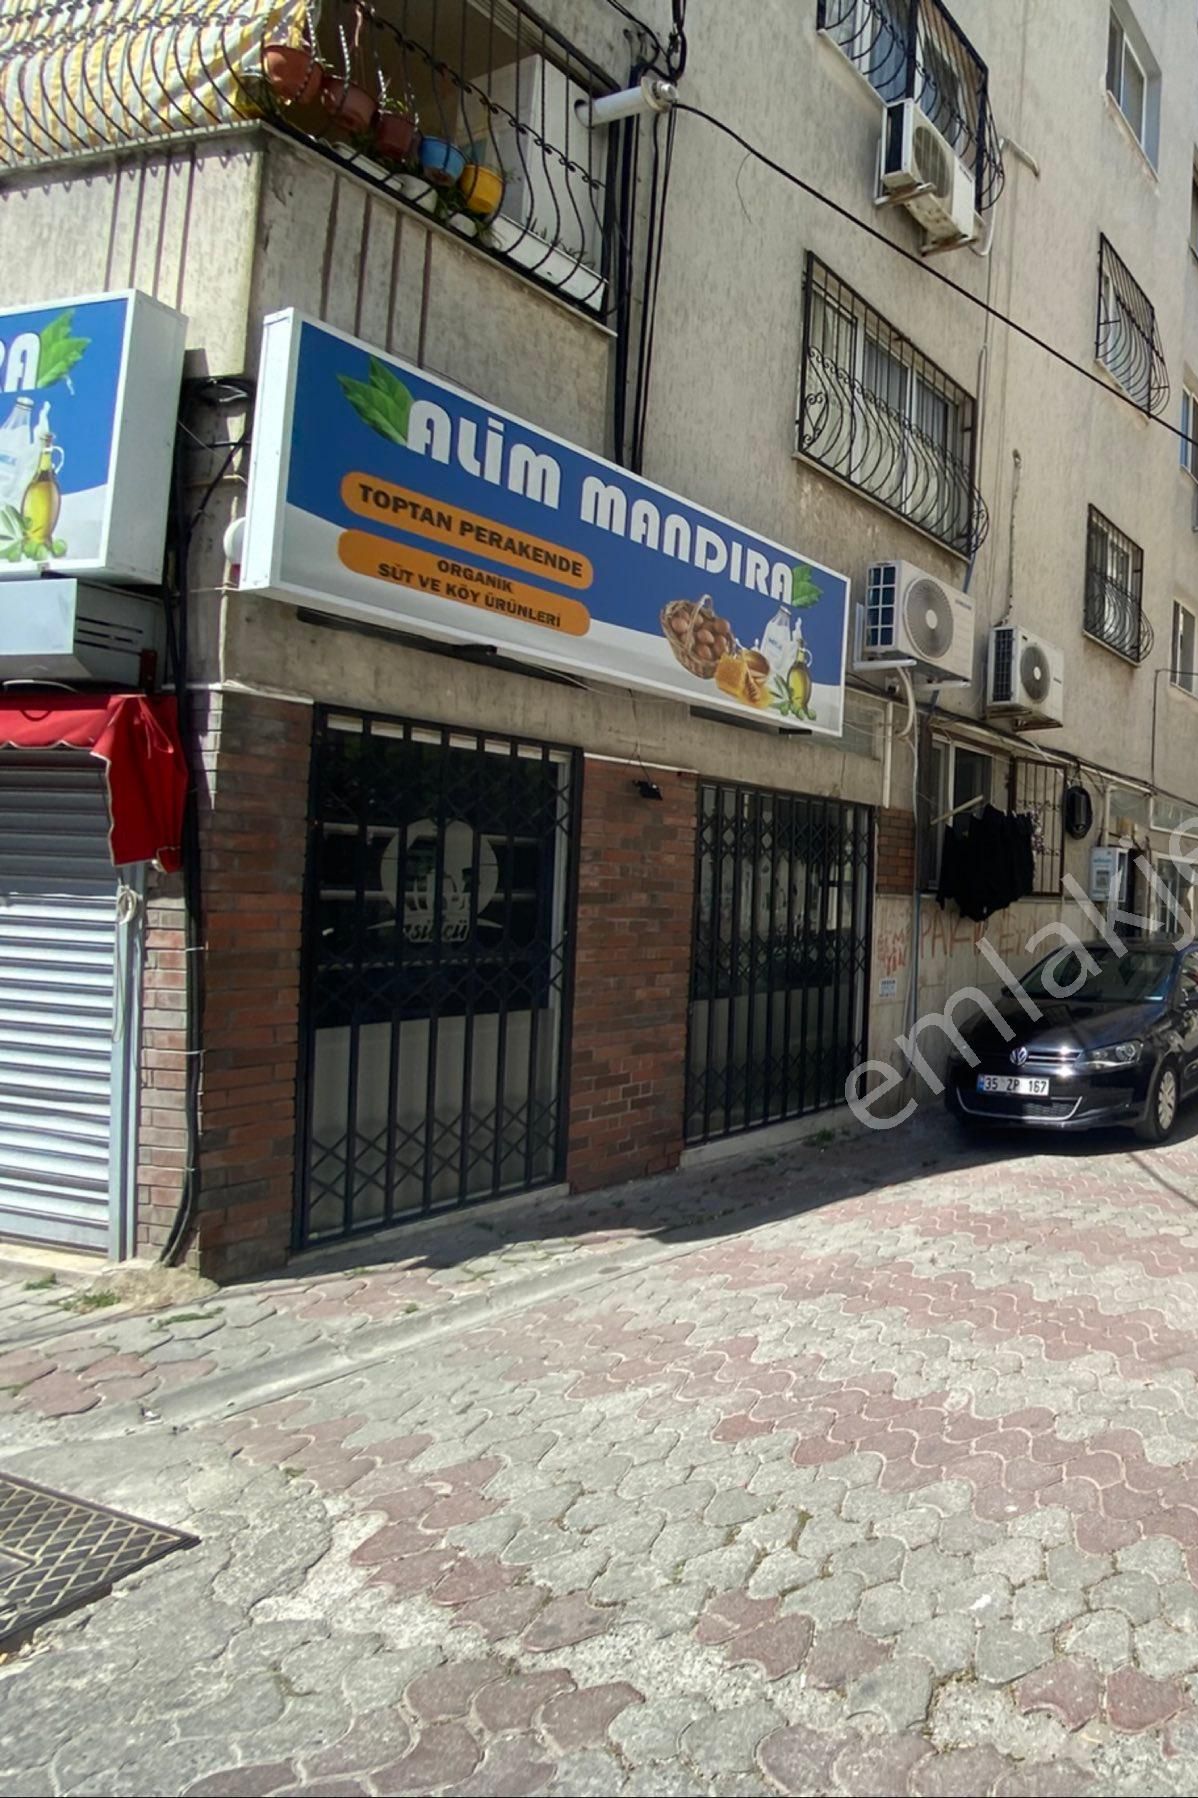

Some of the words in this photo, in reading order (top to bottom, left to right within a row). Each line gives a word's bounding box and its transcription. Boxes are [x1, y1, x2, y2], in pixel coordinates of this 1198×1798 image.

[0, 332, 42, 393] A
[359, 483, 452, 532] TOPTAN
[459, 520, 583, 578] PERAKENDE
[407, 399, 562, 510] ALİM
[580, 475, 794, 605] MANDIRA
[378, 560, 414, 584] SÜT
[418, 573, 441, 592] VE
[446, 583, 481, 603] KÖY
[484, 591, 561, 627] ÜRÜNLERİ
[985, 1077, 998, 1089] 35
[1006, 1078, 1021, 1091] ZP
[1028, 1080, 1047, 1093] 167
